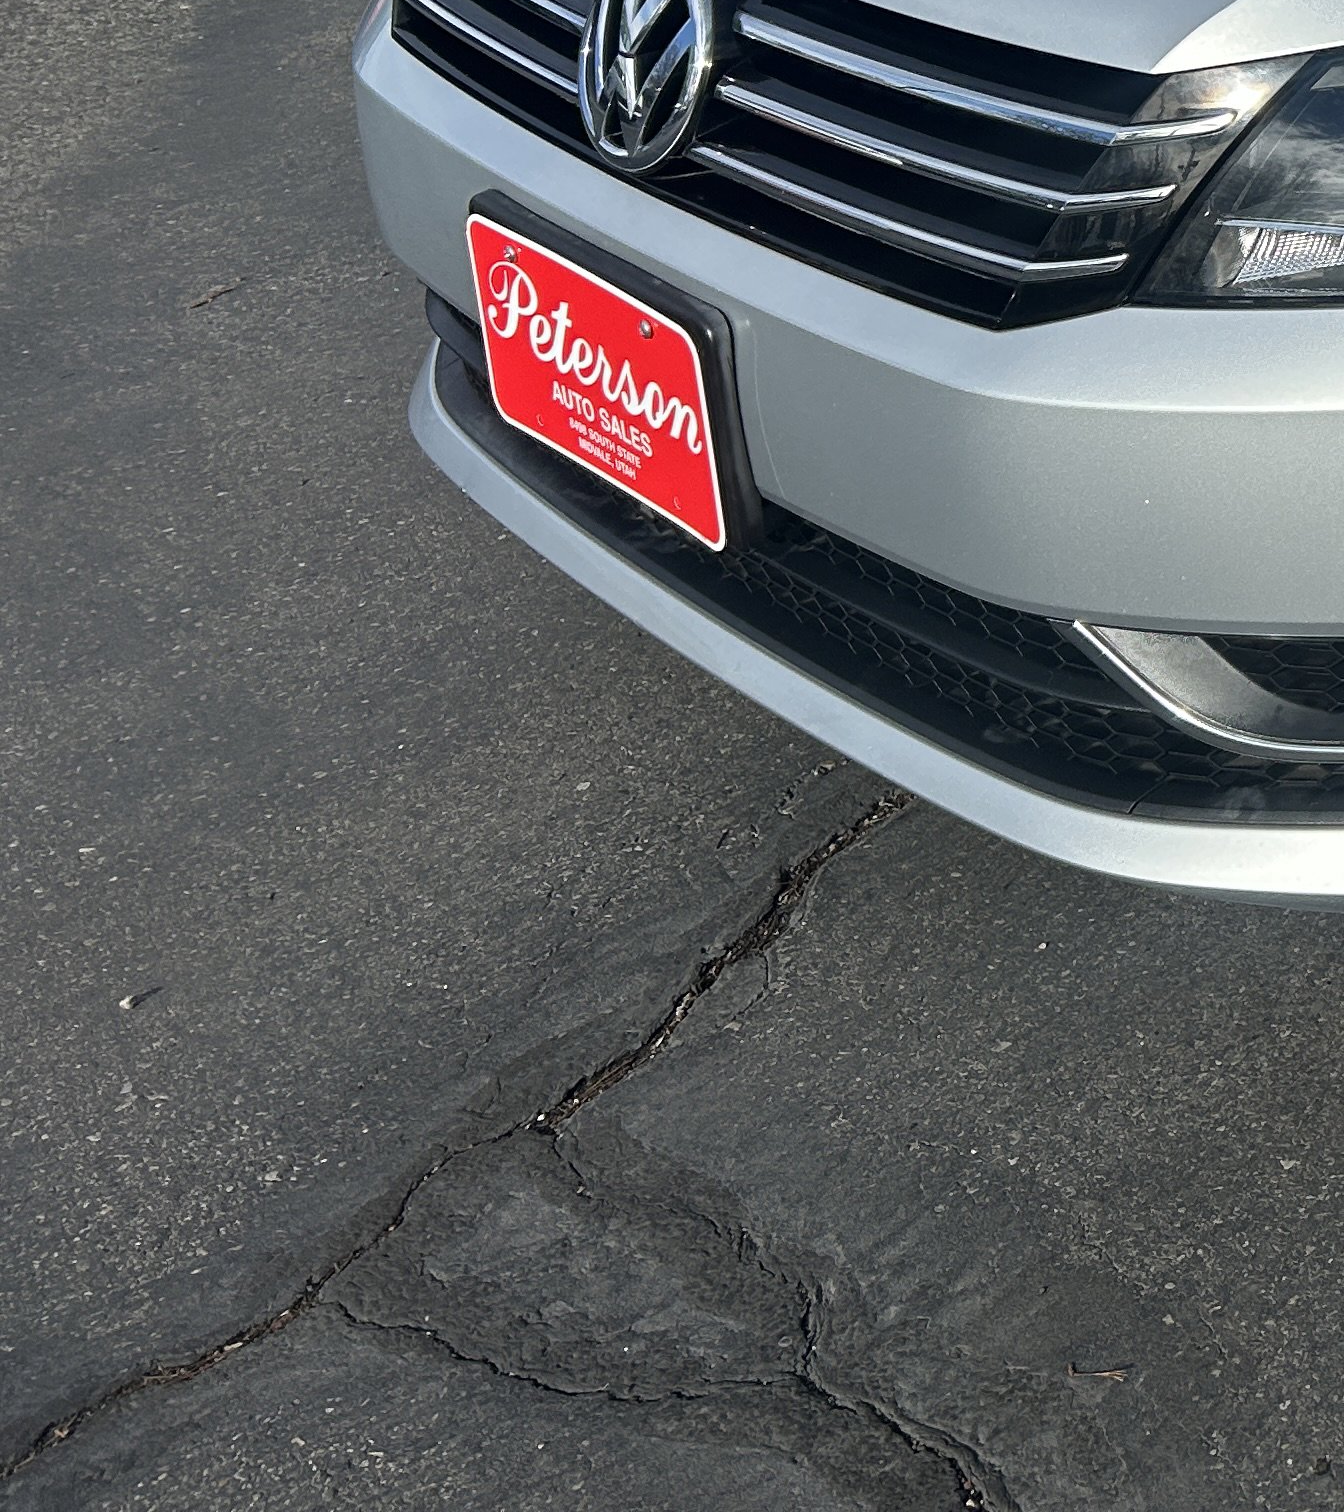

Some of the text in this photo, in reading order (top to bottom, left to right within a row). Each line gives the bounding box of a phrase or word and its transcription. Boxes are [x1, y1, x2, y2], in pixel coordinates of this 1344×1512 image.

[487, 261, 701, 455] Peterson
[553, 380, 653, 457] AUTO SALES
[588, 427, 617, 453] SOUTH
[616, 445, 641, 469] STATE
[614, 457, 636, 480] UTAH
